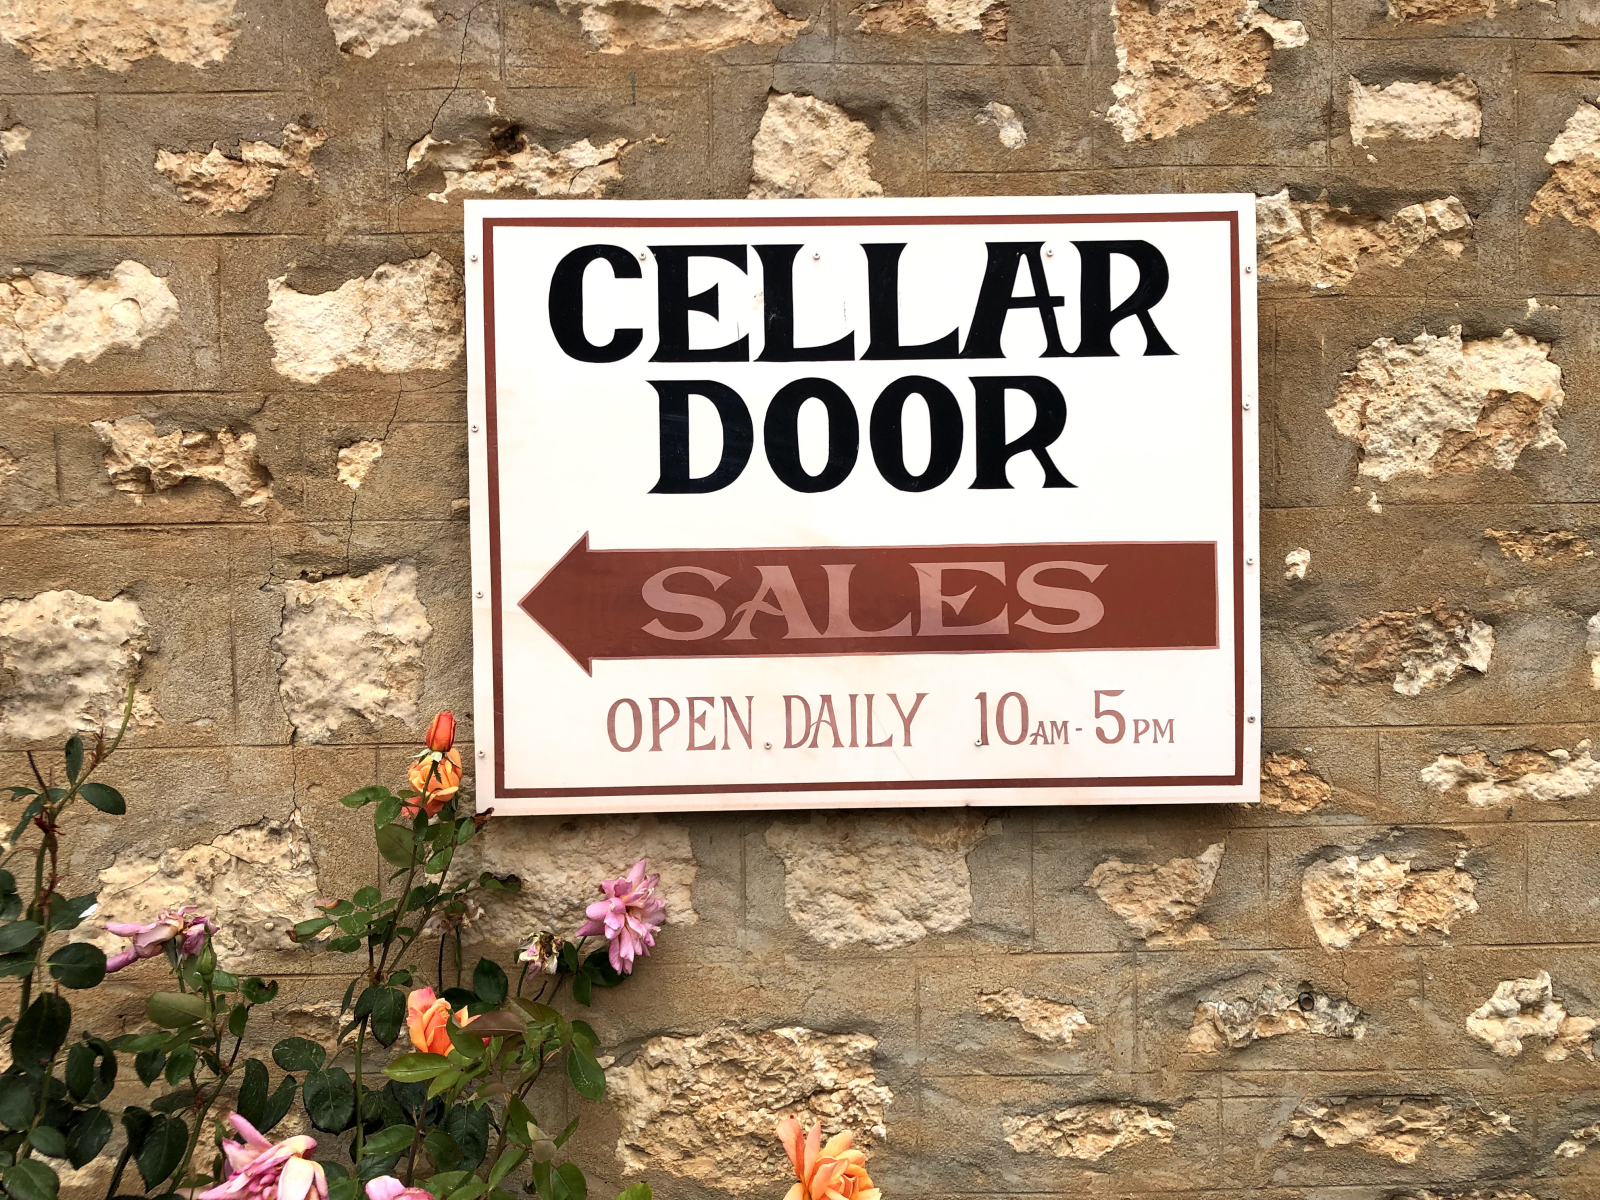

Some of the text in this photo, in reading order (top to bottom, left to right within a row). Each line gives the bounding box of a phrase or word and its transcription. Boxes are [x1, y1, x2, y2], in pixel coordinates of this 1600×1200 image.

[549, 239, 1178, 363] CELLAR
[647, 375, 1077, 495] DOOR
[641, 560, 1109, 642] SALES
[607, 695, 755, 753] OPEN
[783, 692, 930, 749] DAILY
